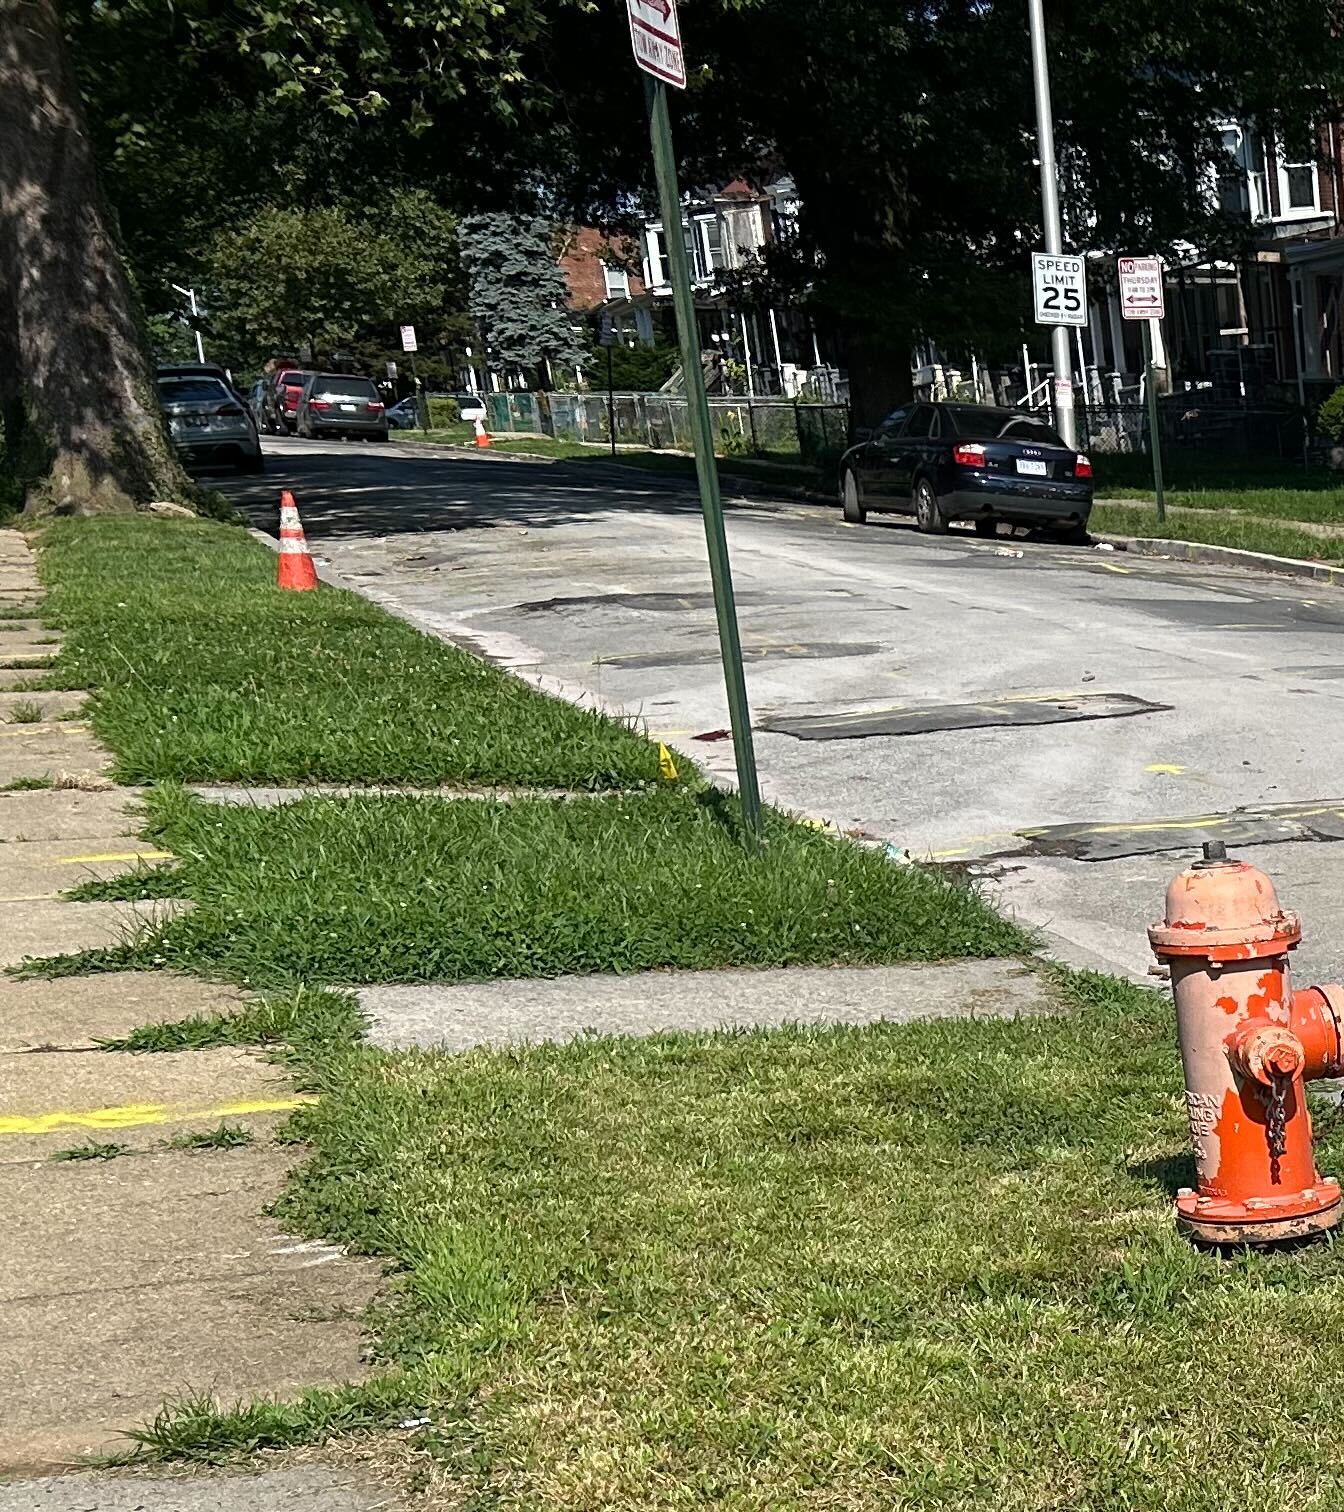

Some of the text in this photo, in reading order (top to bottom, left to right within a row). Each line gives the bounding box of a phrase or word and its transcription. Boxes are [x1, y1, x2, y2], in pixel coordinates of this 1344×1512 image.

[1038, 260, 1080, 273] SPEED
[1120, 260, 1135, 273] NO
[1043, 274, 1076, 286] LIMIT
[1042, 286, 1081, 311] 25
